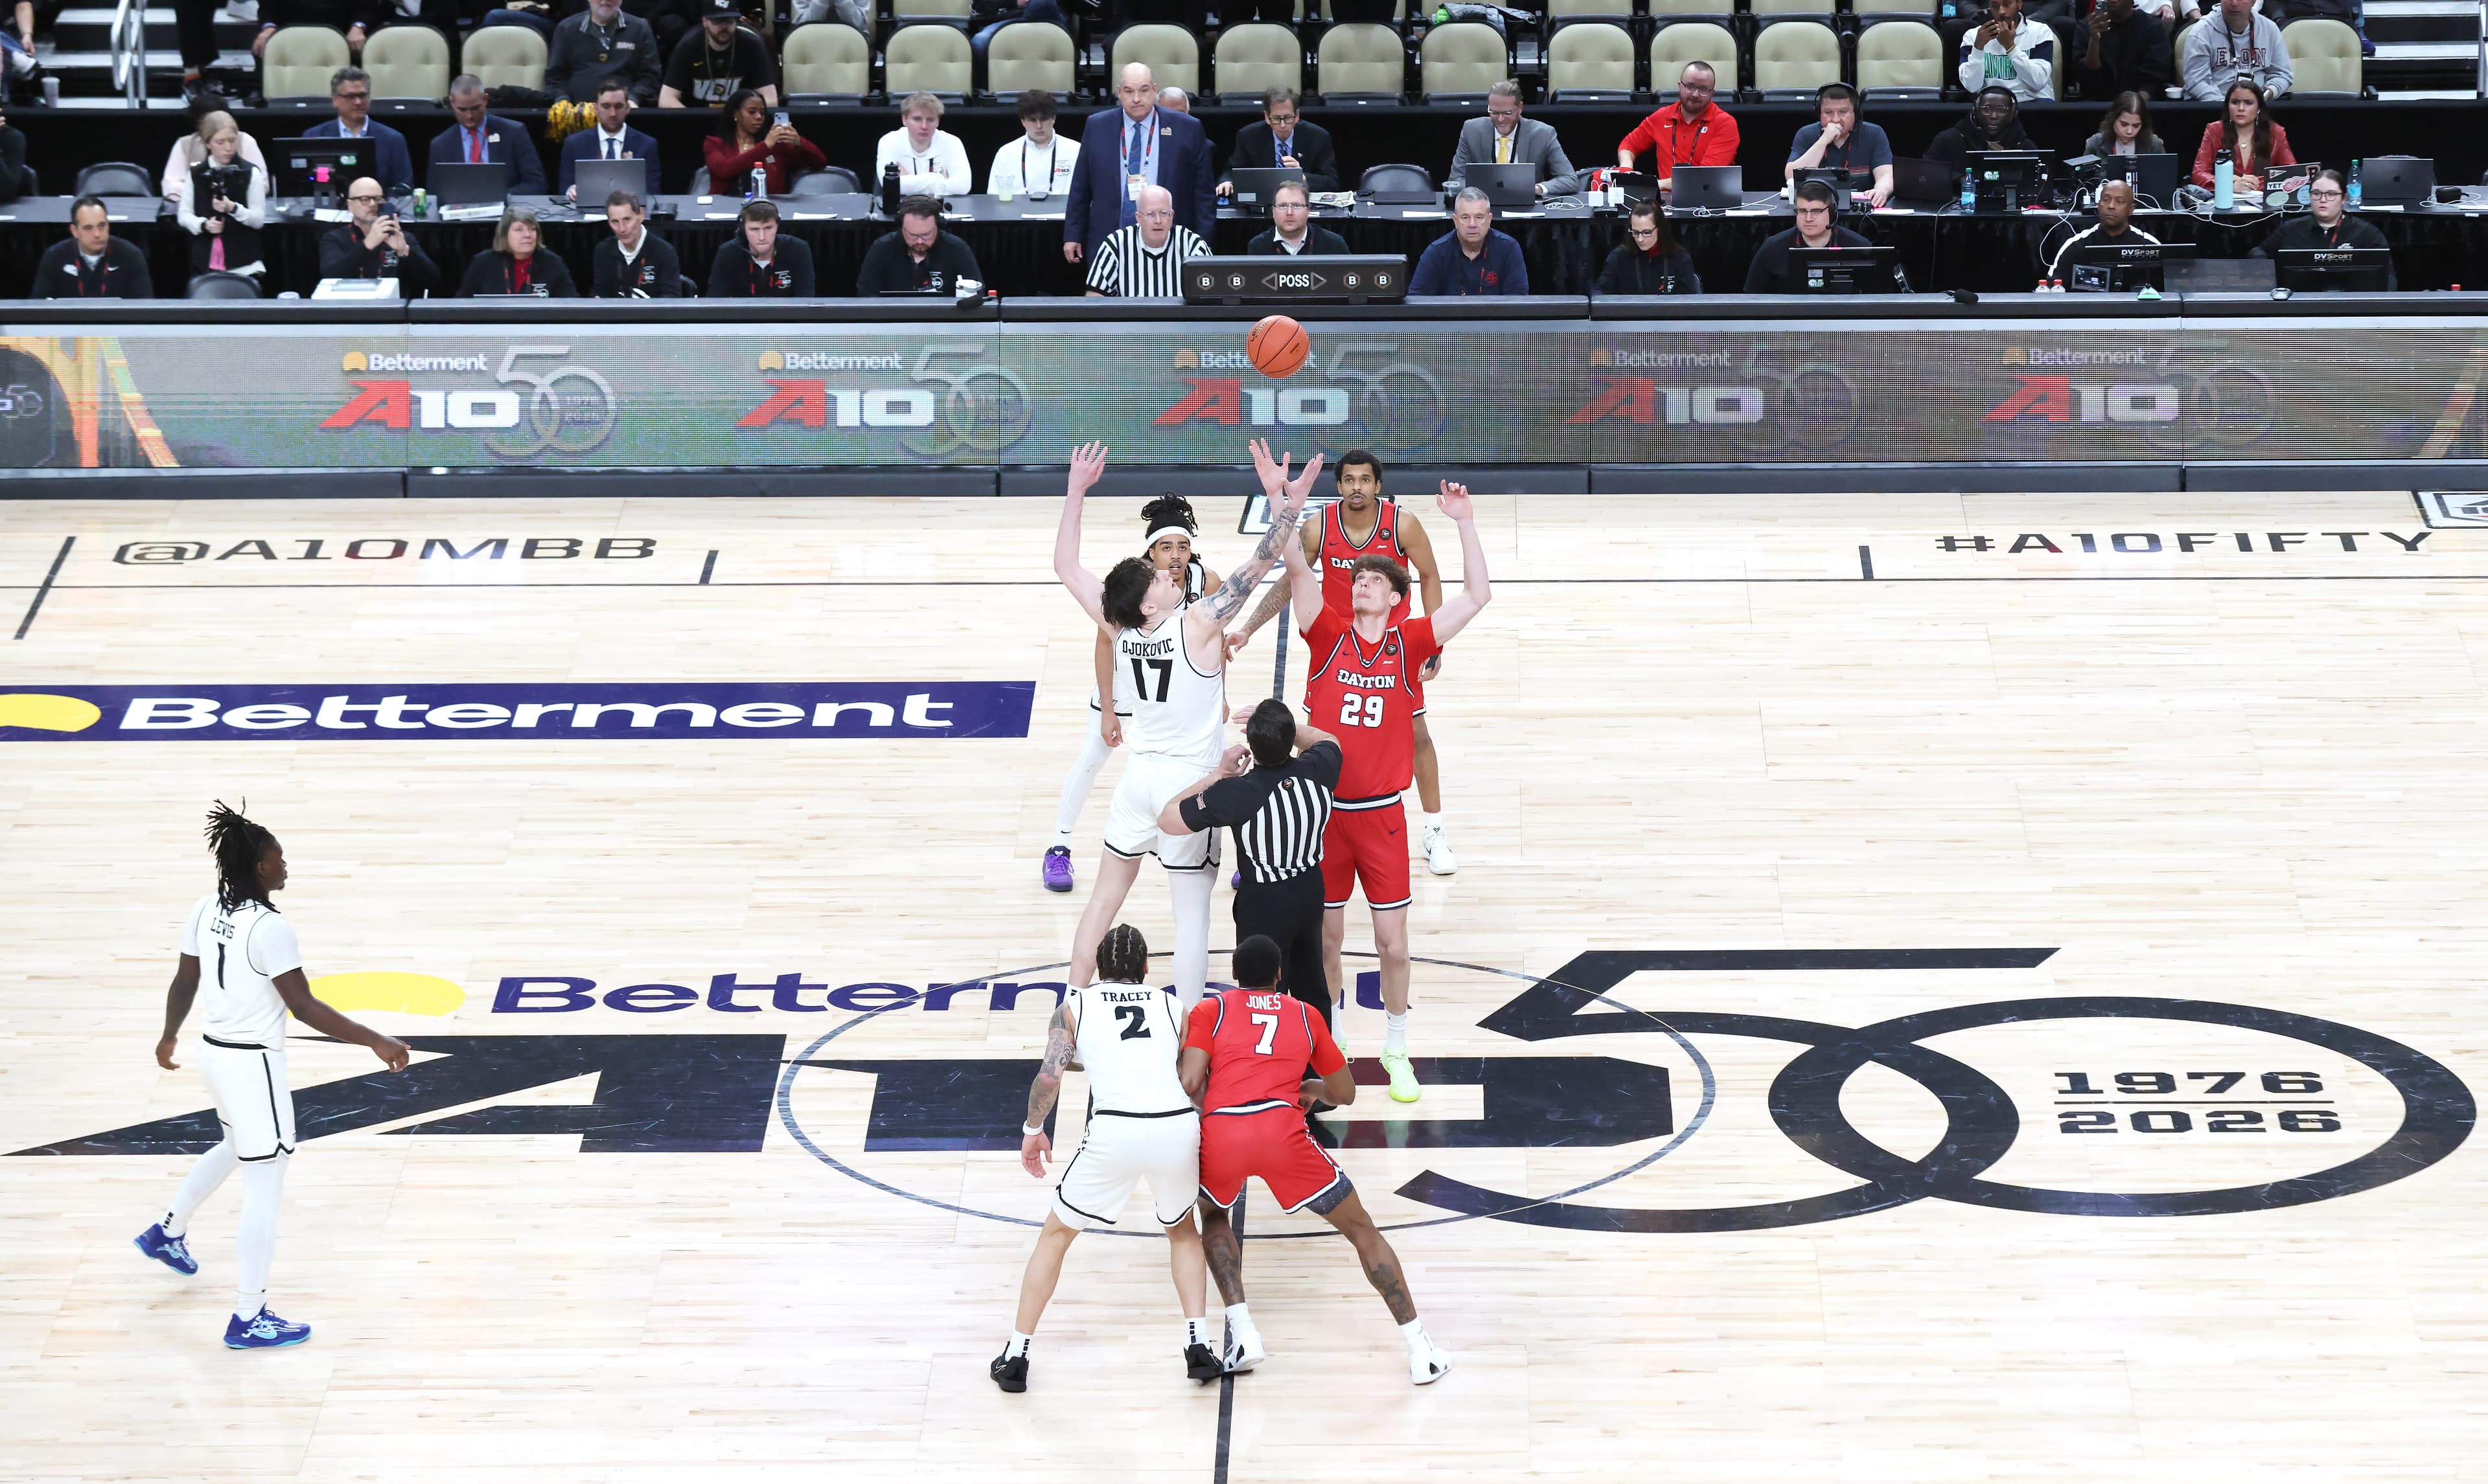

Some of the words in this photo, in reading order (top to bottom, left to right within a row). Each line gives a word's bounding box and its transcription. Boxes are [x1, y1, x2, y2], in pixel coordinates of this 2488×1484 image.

[2216, 47, 2266, 68] ELON
[1202, 277, 1210, 286] B
[1233, 277, 1241, 286] B
[1279, 274, 1309, 287] POSS
[1348, 276, 1356, 285] B
[1379, 275, 1387, 284] B
[369, 353, 487, 371] Betterment
[785, 352, 903, 370] Betterment
[1201, 351, 1316, 369] Bettet
[1615, 350, 1729, 367] Betterment
[2029, 347, 2147, 365] Betterment
[318, 380, 520, 428] A10
[735, 378, 936, 427] A10
[1151, 378, 1350, 426] A10
[1565, 376, 1765, 424] A10
[1981, 374, 2180, 422] A10
[112, 537, 657, 565] @A10MBB
[1935, 532, 2432, 553] #A10FIFTY
[1122, 638, 1174, 657] DJOKOVIC
[1131, 657, 1173, 702] 17
[1337, 668, 1396, 689] DAYTON
[119, 693, 954, 730] Betterment
[1339, 691, 1384, 728] 29
[211, 917, 235, 939] LEWIS
[218, 941, 226, 990] 1
[1101, 992, 1151, 1002] TRACEY
[1246, 994, 1282, 1010] JONES
[1114, 1005, 1151, 1041] 2
[1250, 1012, 1278, 1056] 7
[1396, 948, 2477, 1233] 50
[2054, 1071, 2324, 1094] 1976
[2058, 1110, 2342, 1133] 2026
